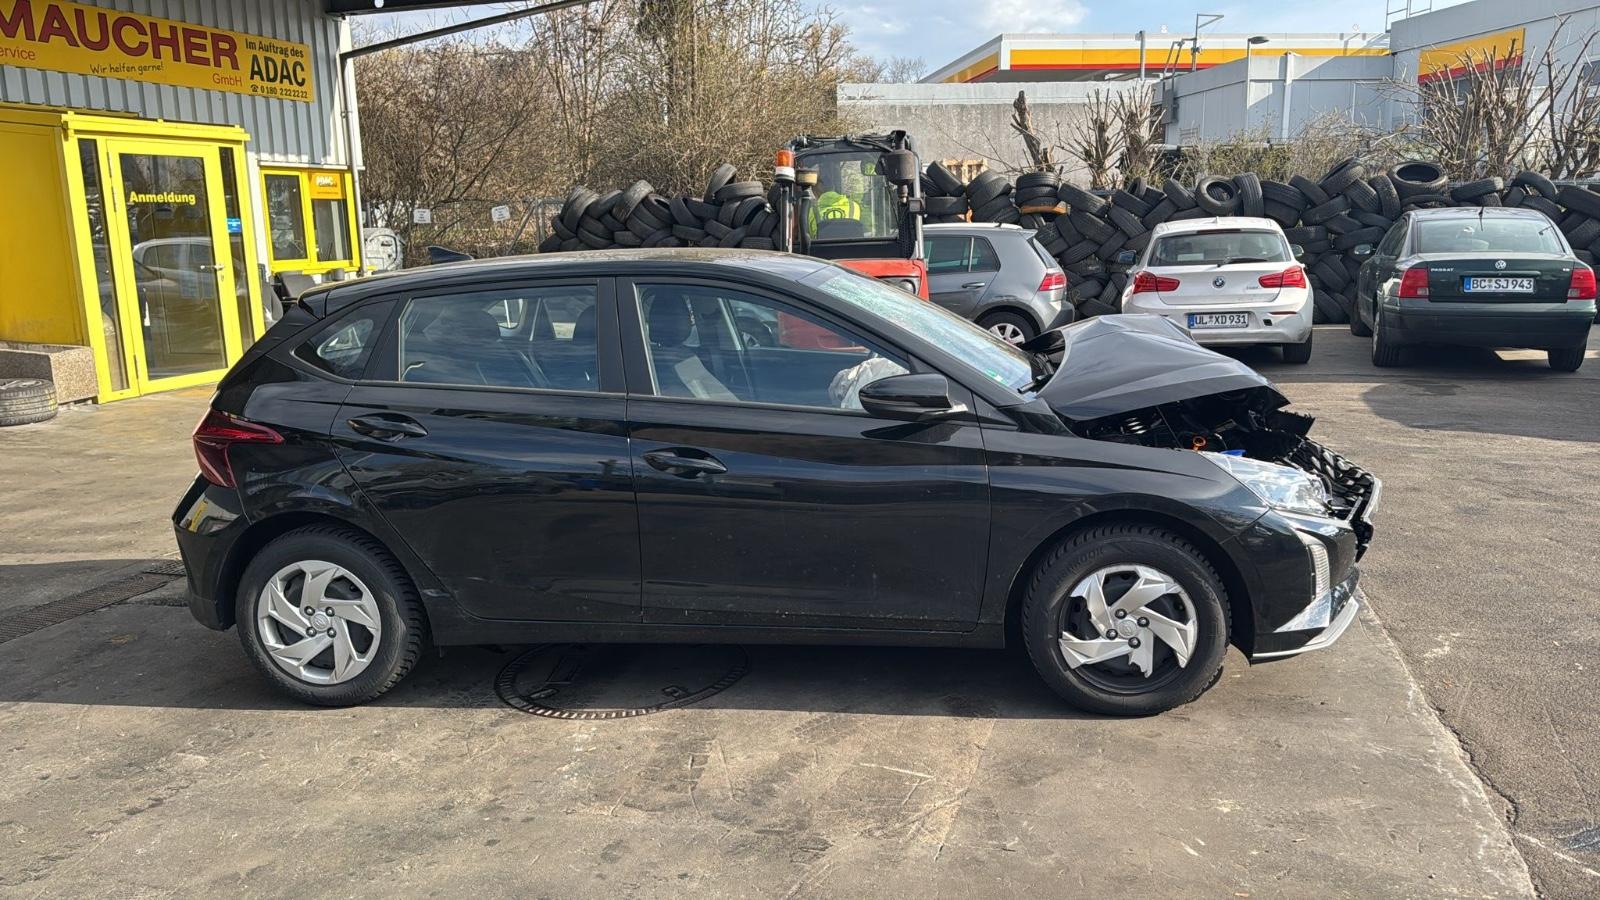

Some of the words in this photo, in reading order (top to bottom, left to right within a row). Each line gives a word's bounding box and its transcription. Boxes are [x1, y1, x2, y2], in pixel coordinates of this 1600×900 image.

[0, 0, 239, 70] MAUCHER
[245, 38, 257, 50] Im
[258, 41, 289, 57] Auftrag
[290, 47, 304, 58] des
[90, 64, 107, 74] Wir
[109, 63, 136, 73] helfen
[137, 61, 164, 75] gerne!
[250, 54, 306, 87] ADAC
[212, 73, 242, 87] GmbH
[129, 191, 196, 205] Anmeldung
[1472, 279, 1487, 289] BC
[1494, 279, 1509, 289] SJ
[1511, 279, 1532, 290] 943
[1195, 315, 1208, 325] UL
[1214, 315, 1227, 325] XD
[1229, 314, 1247, 325] 931
